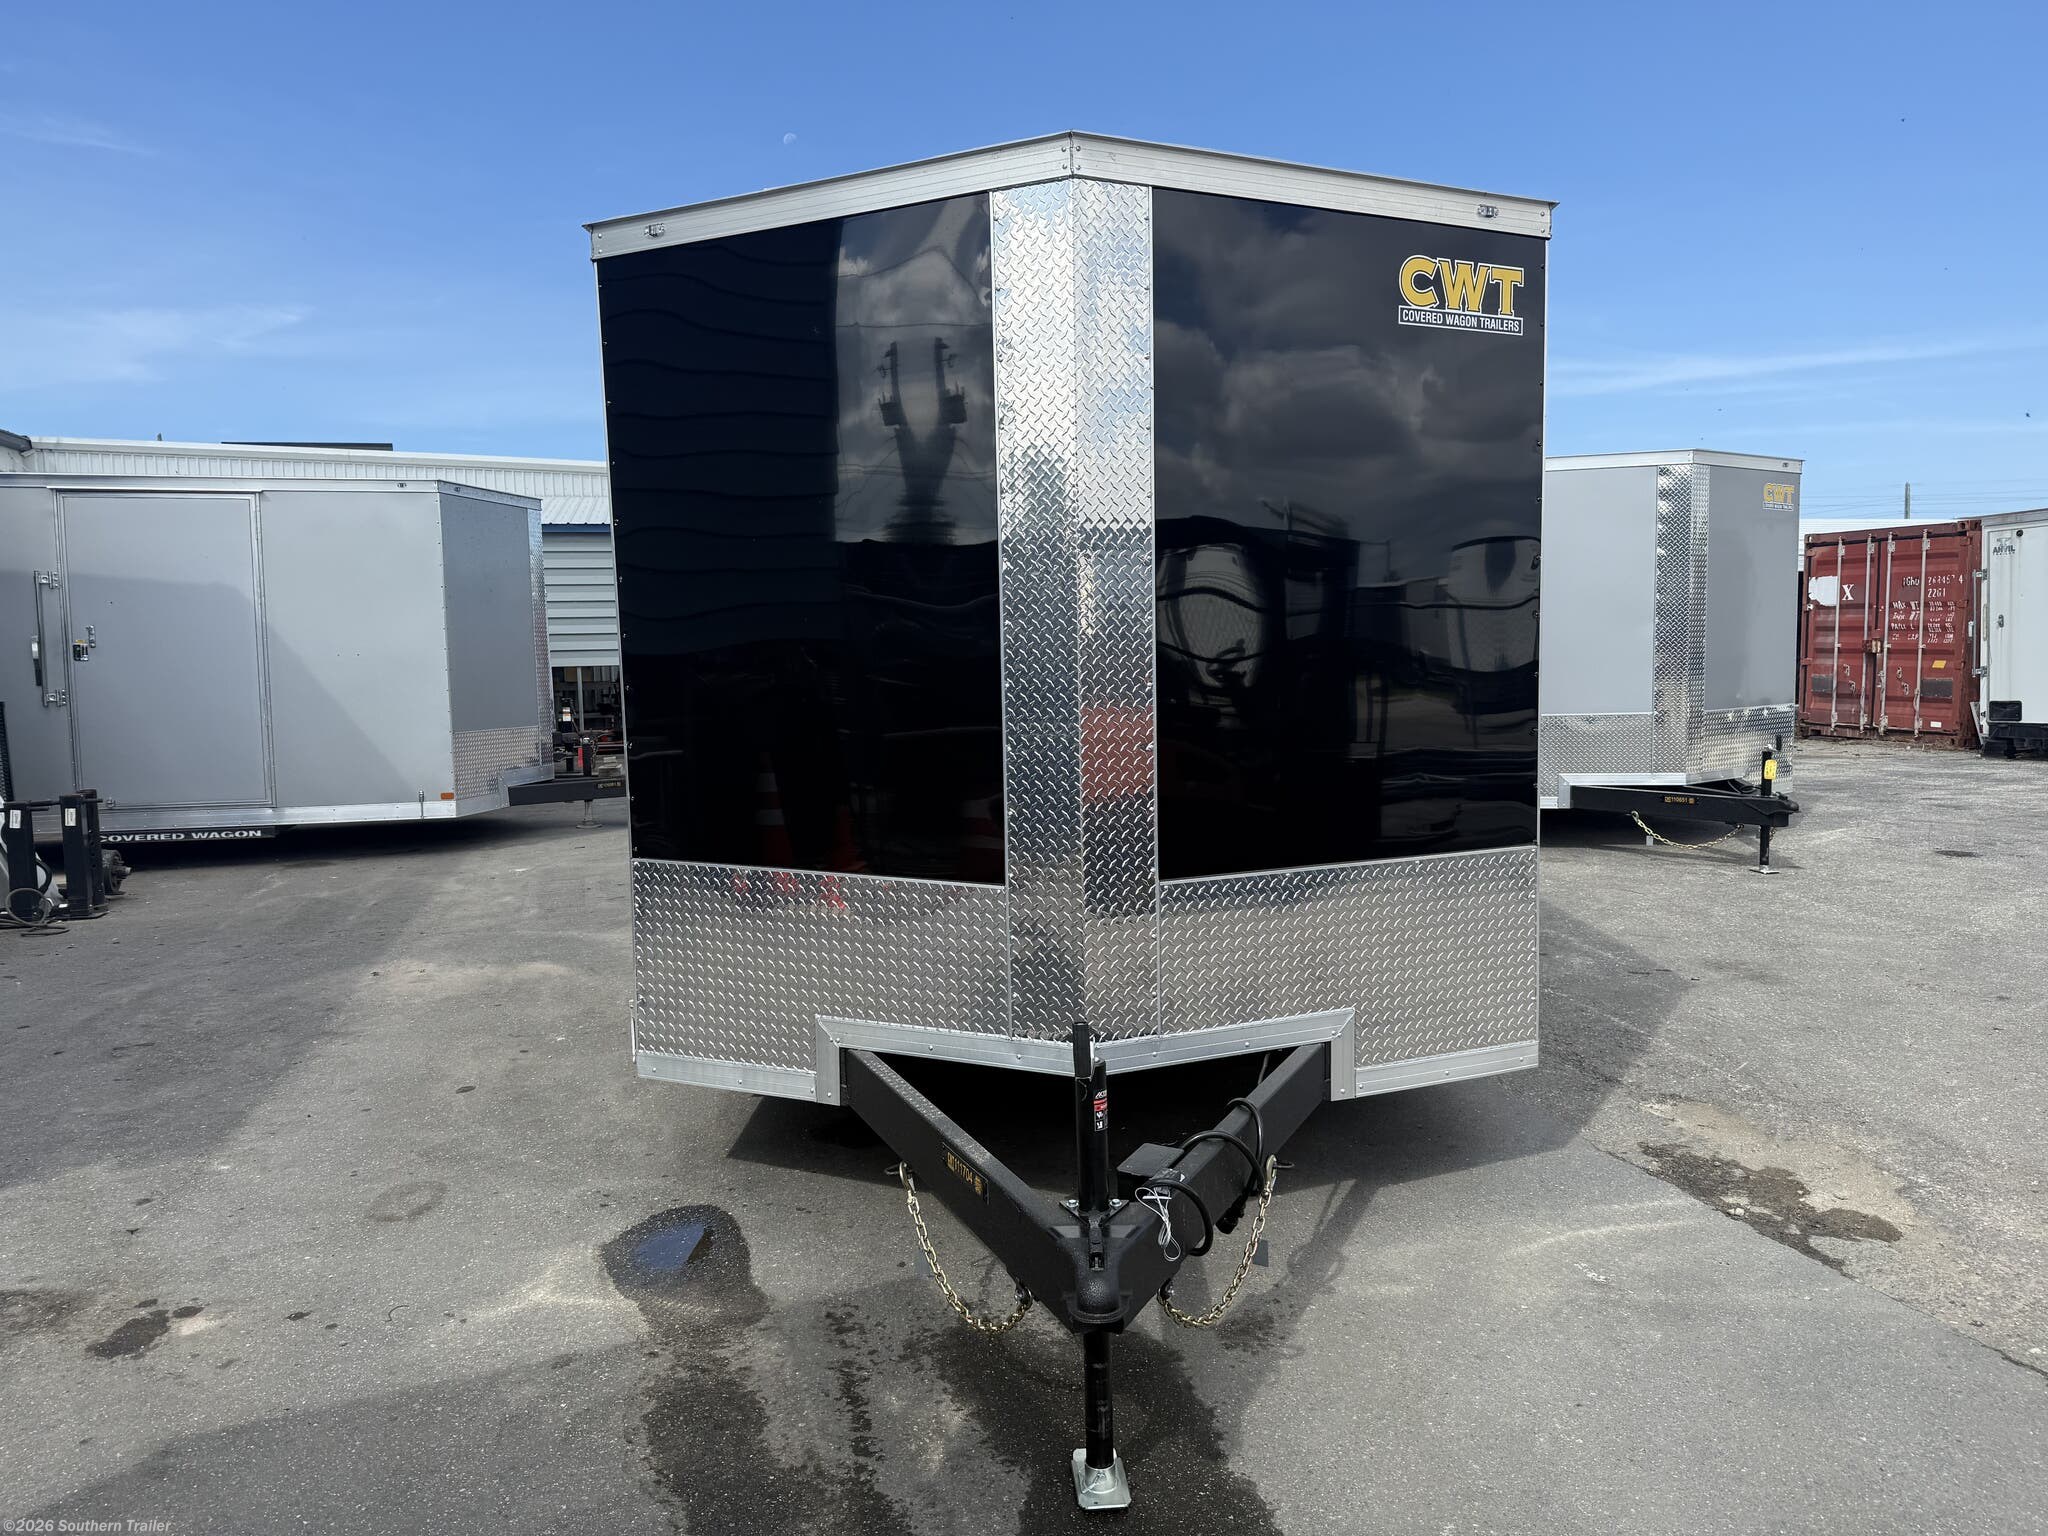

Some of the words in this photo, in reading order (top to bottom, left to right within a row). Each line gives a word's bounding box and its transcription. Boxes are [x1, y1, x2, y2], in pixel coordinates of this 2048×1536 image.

[1399, 255, 1524, 317] CWT
[1402, 309, 1443, 324] COVERED
[1445, 313, 1478, 328] WAGON
[1479, 317, 1520, 332] TRAILERS
[1763, 483, 1795, 504] CWT
[1841, 584, 1855, 601] X
[191, 830, 262, 839] WAGON
